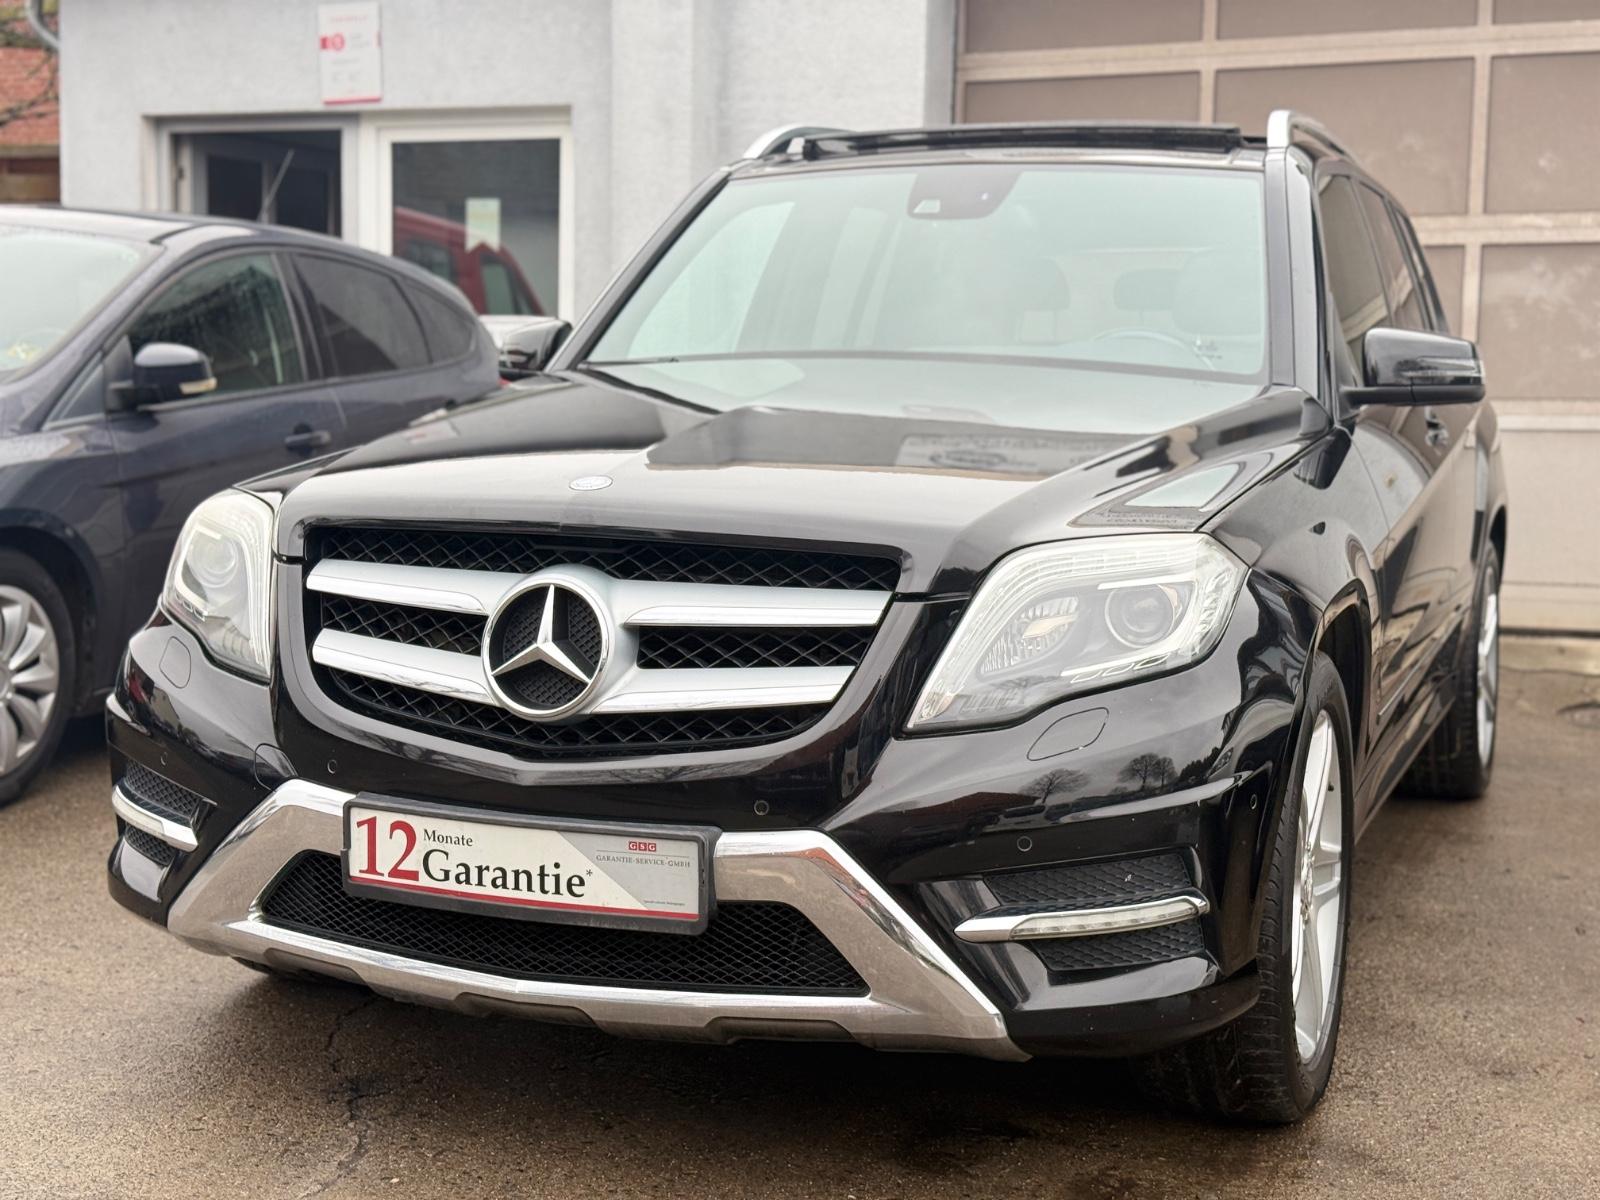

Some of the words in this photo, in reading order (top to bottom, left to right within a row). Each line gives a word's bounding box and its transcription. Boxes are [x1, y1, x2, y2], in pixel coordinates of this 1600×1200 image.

[356, 815, 420, 882] 12
[423, 828, 474, 847] Monate
[629, 841, 657, 853] GSG
